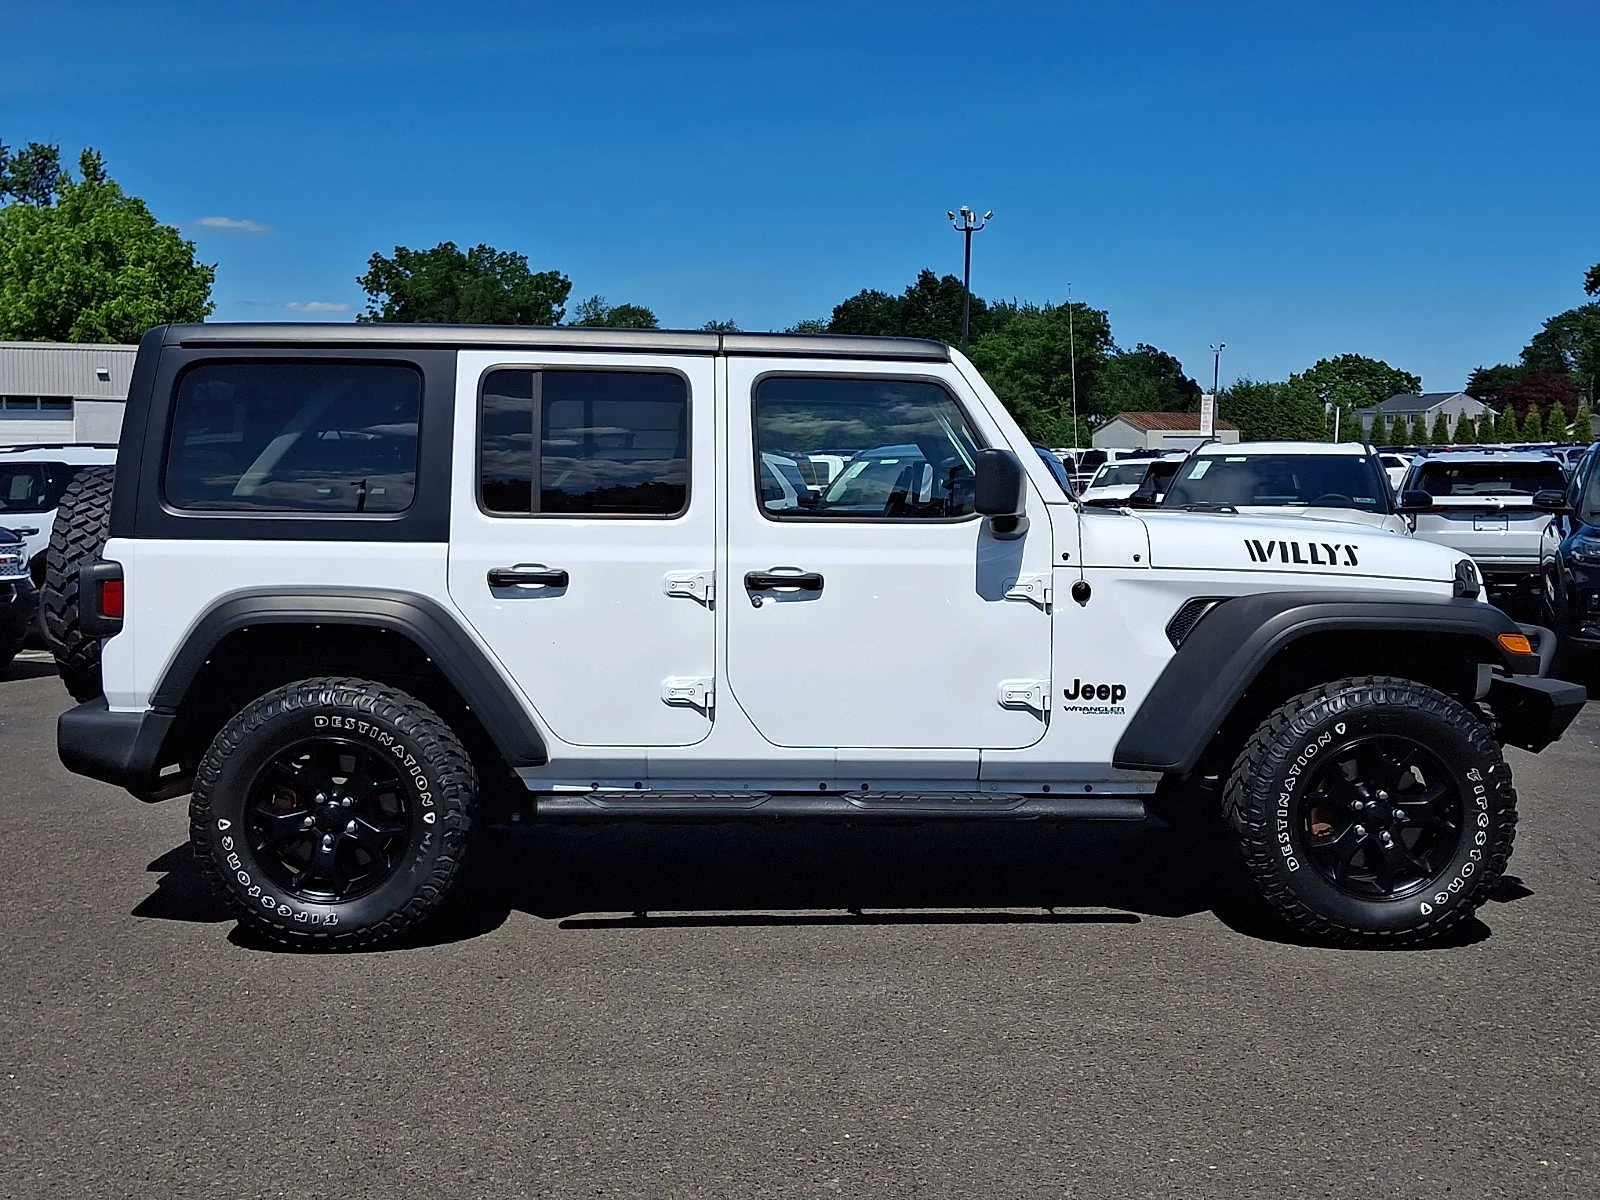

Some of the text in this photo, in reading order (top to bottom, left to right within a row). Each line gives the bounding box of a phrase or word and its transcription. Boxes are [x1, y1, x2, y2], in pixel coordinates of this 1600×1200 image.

[1244, 539, 1359, 567] WILLYS
[1063, 678, 1127, 705] Jeep
[313, 715, 434, 807] DESTINATION
[1276, 732, 1332, 872] DESTINATION
